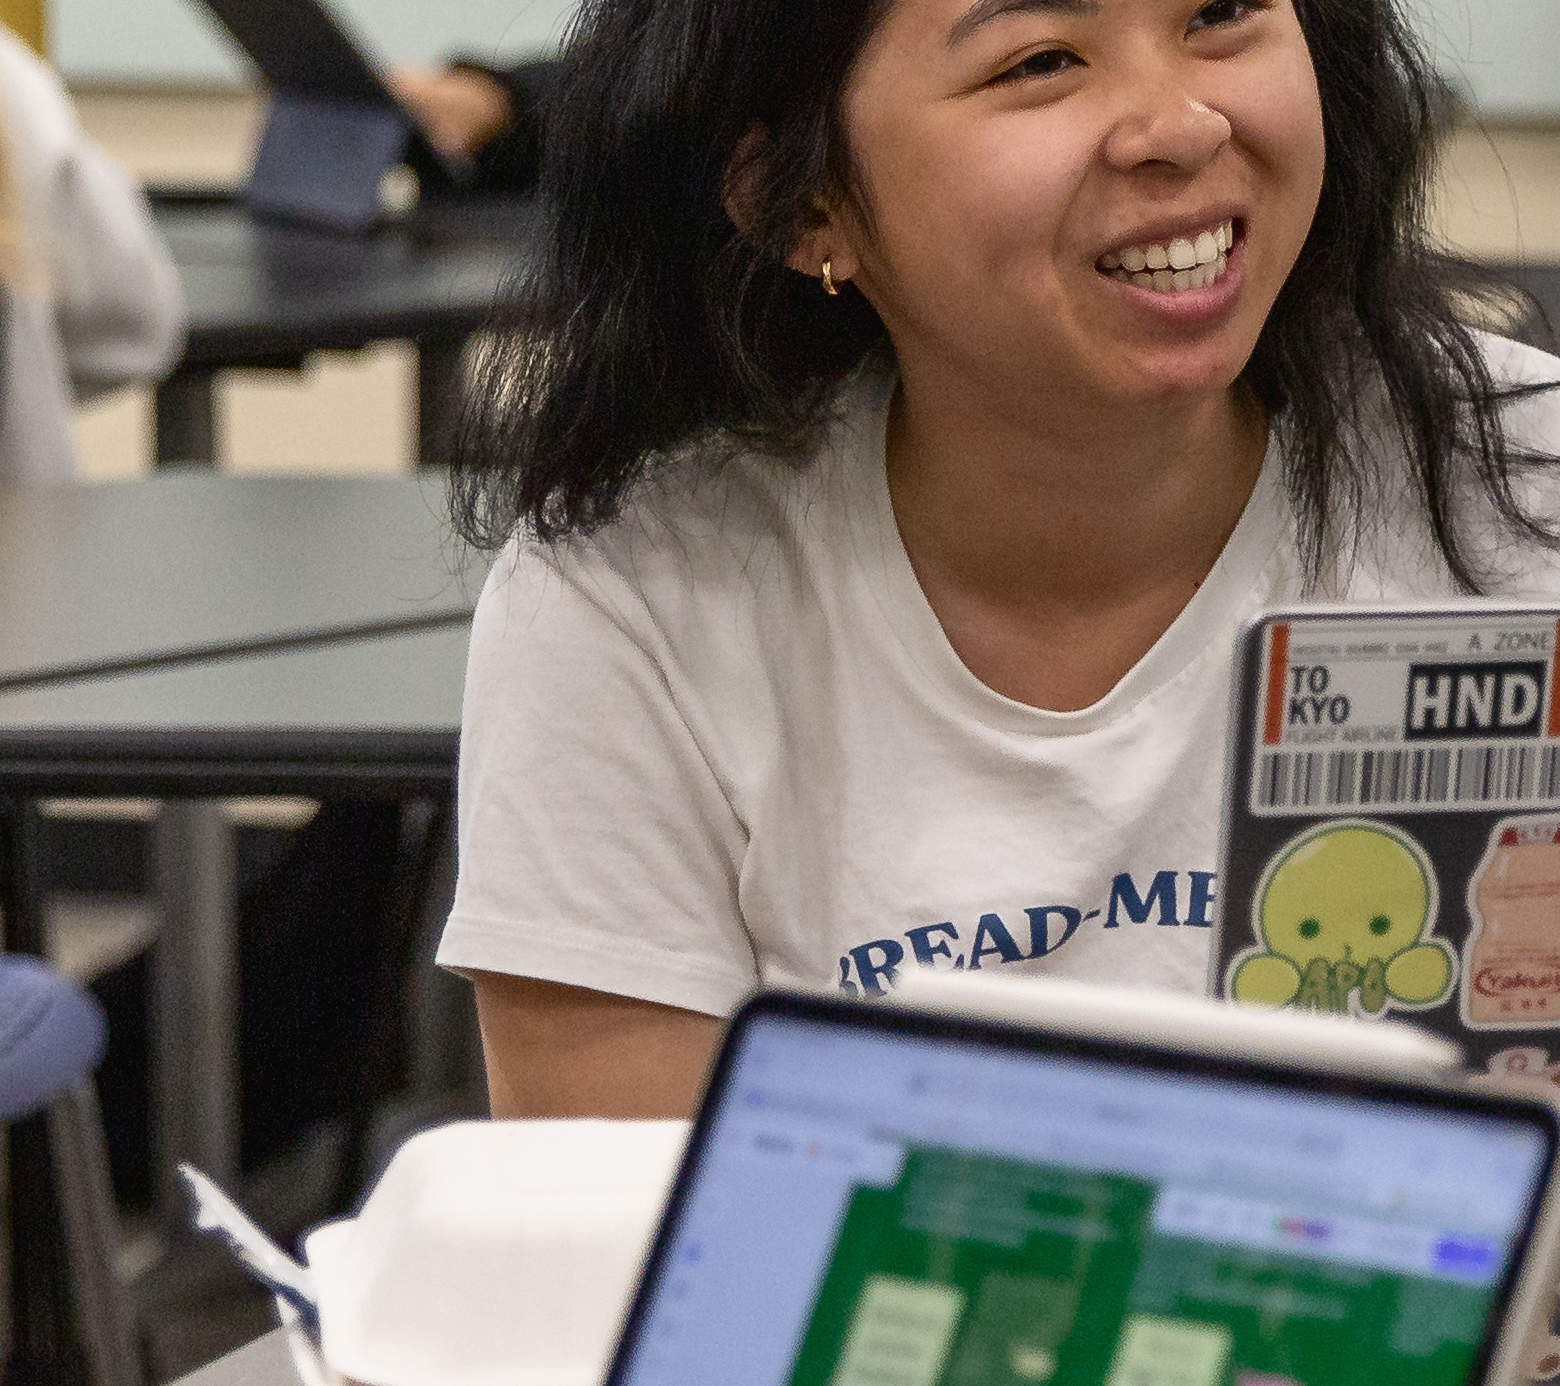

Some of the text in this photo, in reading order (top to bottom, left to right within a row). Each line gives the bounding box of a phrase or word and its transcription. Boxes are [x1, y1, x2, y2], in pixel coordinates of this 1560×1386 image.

[1466, 633, 1484, 651] A
[1493, 631, 1552, 652] ZONE
[1291, 665, 1330, 694] TO
[1288, 694, 1352, 725] KYO
[1410, 673, 1539, 730] HND
